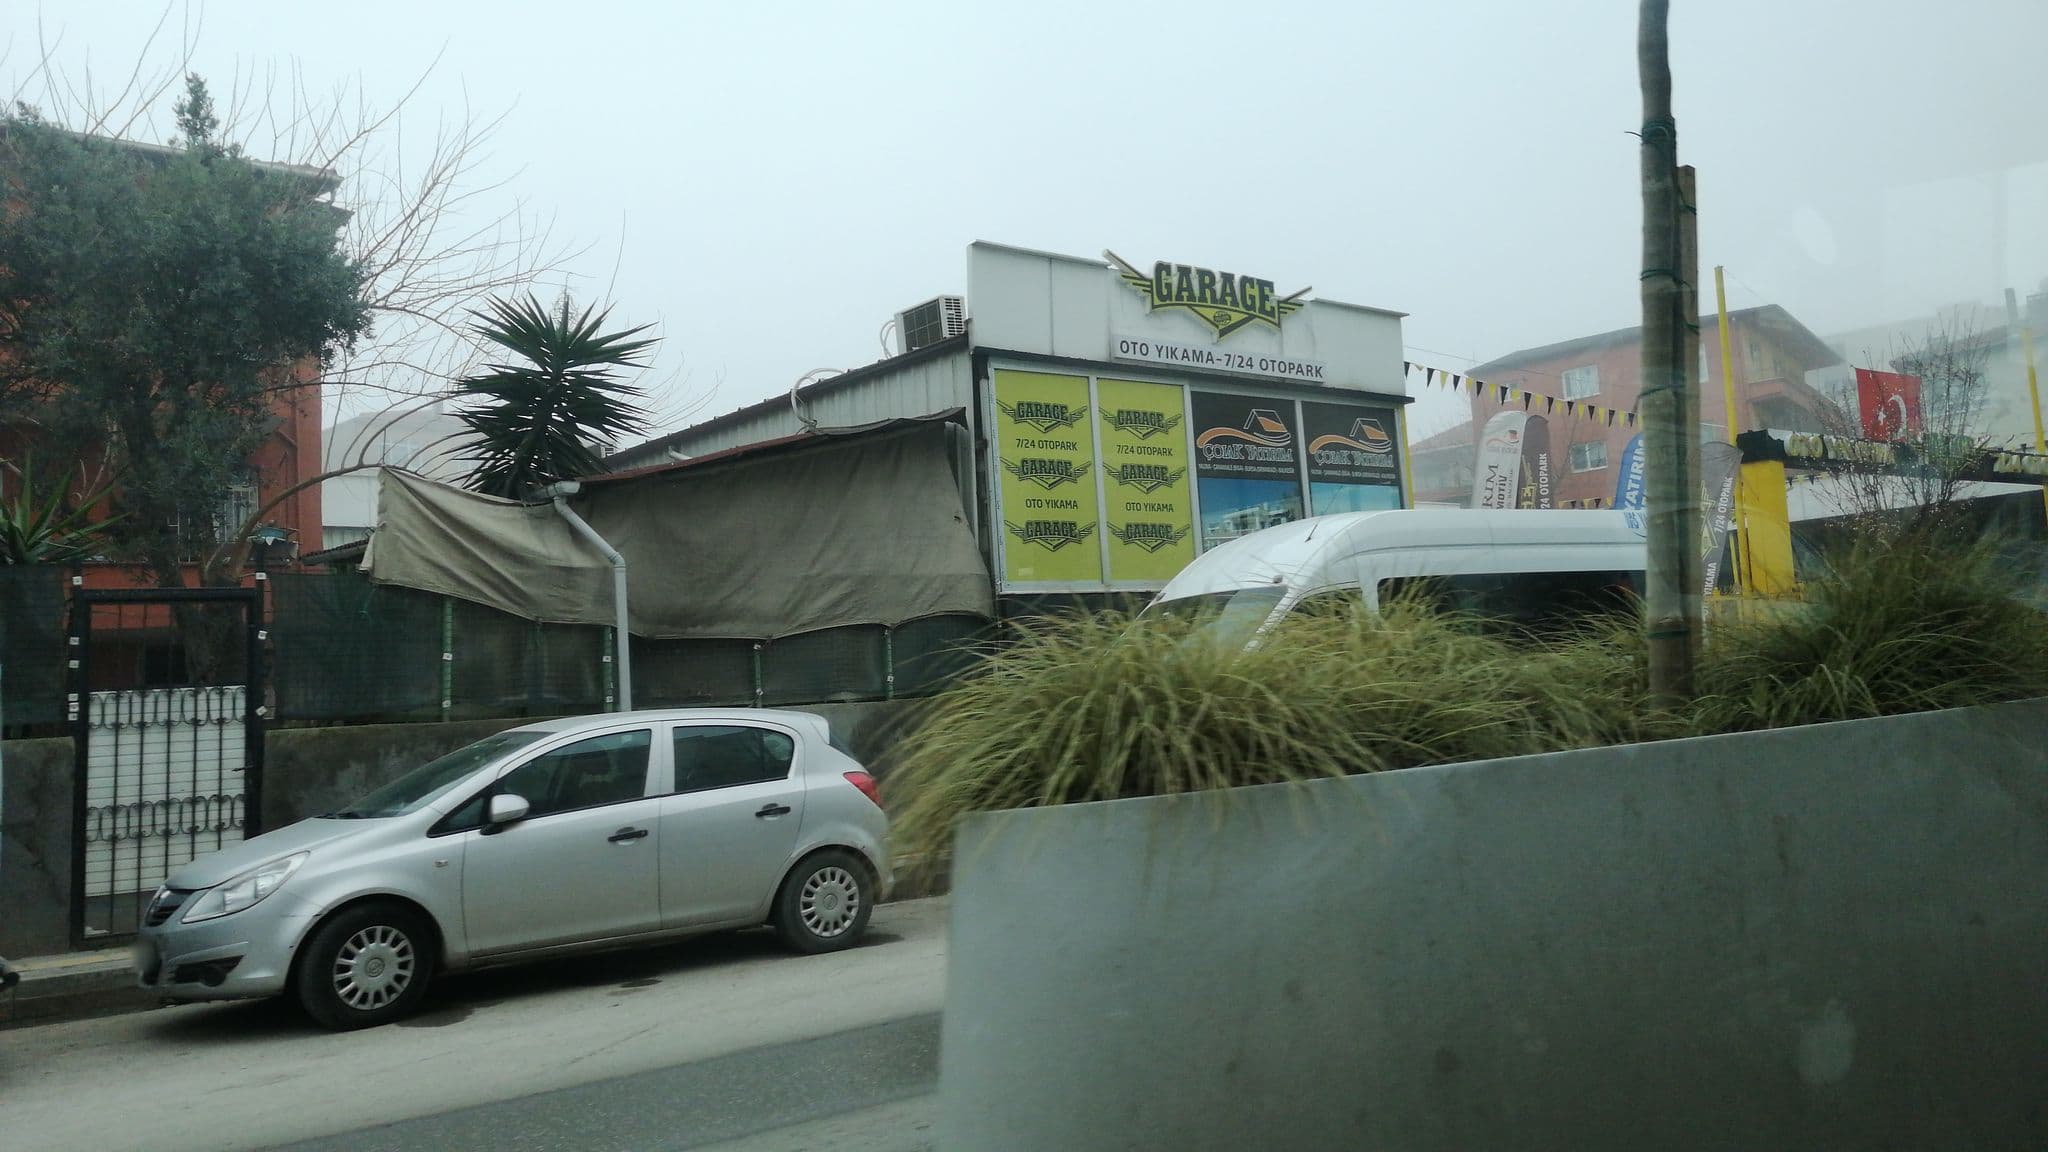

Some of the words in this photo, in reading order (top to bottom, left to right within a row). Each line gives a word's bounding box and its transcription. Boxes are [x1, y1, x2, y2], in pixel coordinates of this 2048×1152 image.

[1154, 261, 1276, 320] GARAGE
[1120, 340, 1149, 357] OTO
[1259, 358, 1323, 379] OTOPARK
[1017, 401, 1069, 422] GARAGE
[1117, 409, 1165, 428] GARAGE
[1016, 438, 1036, 450] 7/24
[1038, 440, 1078, 452] OTOPARK
[1116, 444, 1135, 455] 7/24
[1136, 446, 1173, 457] OTOPARK
[1021, 458, 1073, 477] GARAGE
[1121, 464, 1169, 481] GARAGE
[1539, 453, 1549, 496] OTOPARK
[1025, 498, 1043, 509] OTO
[1044, 499, 1079, 510] YIKAMA
[1718, 477, 1733, 513] OTOPARK
[1125, 502, 1142, 512] OTO
[1143, 502, 1174, 513] YIKAMA
[1025, 520, 1078, 538] GARAGE
[1125, 523, 1174, 540] GARAGE
[1714, 514, 1726, 533] 7/24
[1703, 562, 1717, 596] YIKAMA
